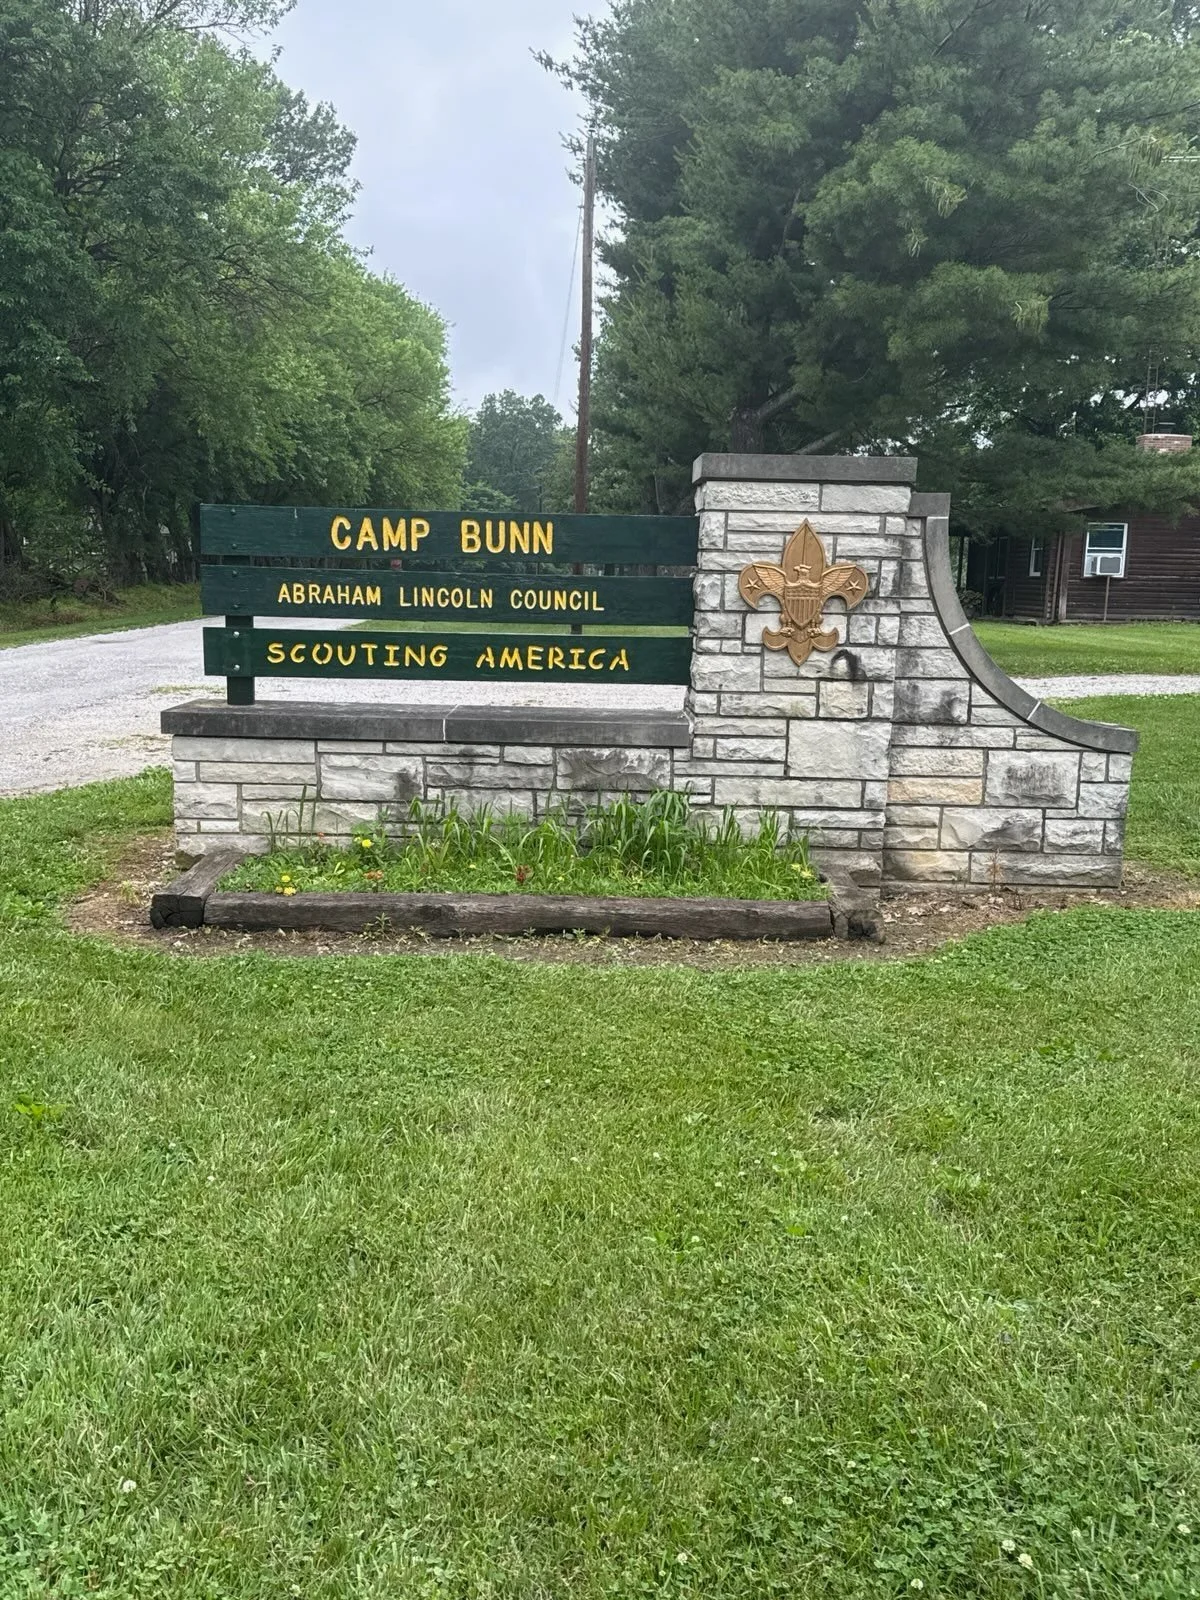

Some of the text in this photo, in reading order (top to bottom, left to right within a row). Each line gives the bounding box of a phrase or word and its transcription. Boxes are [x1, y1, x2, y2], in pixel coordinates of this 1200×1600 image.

[330, 515, 554, 555] CAMP BUNN
[278, 582, 605, 612] ABRAHAM LINCOLN COUNCIL
[267, 641, 630, 672] SCOUTING AMERICA
